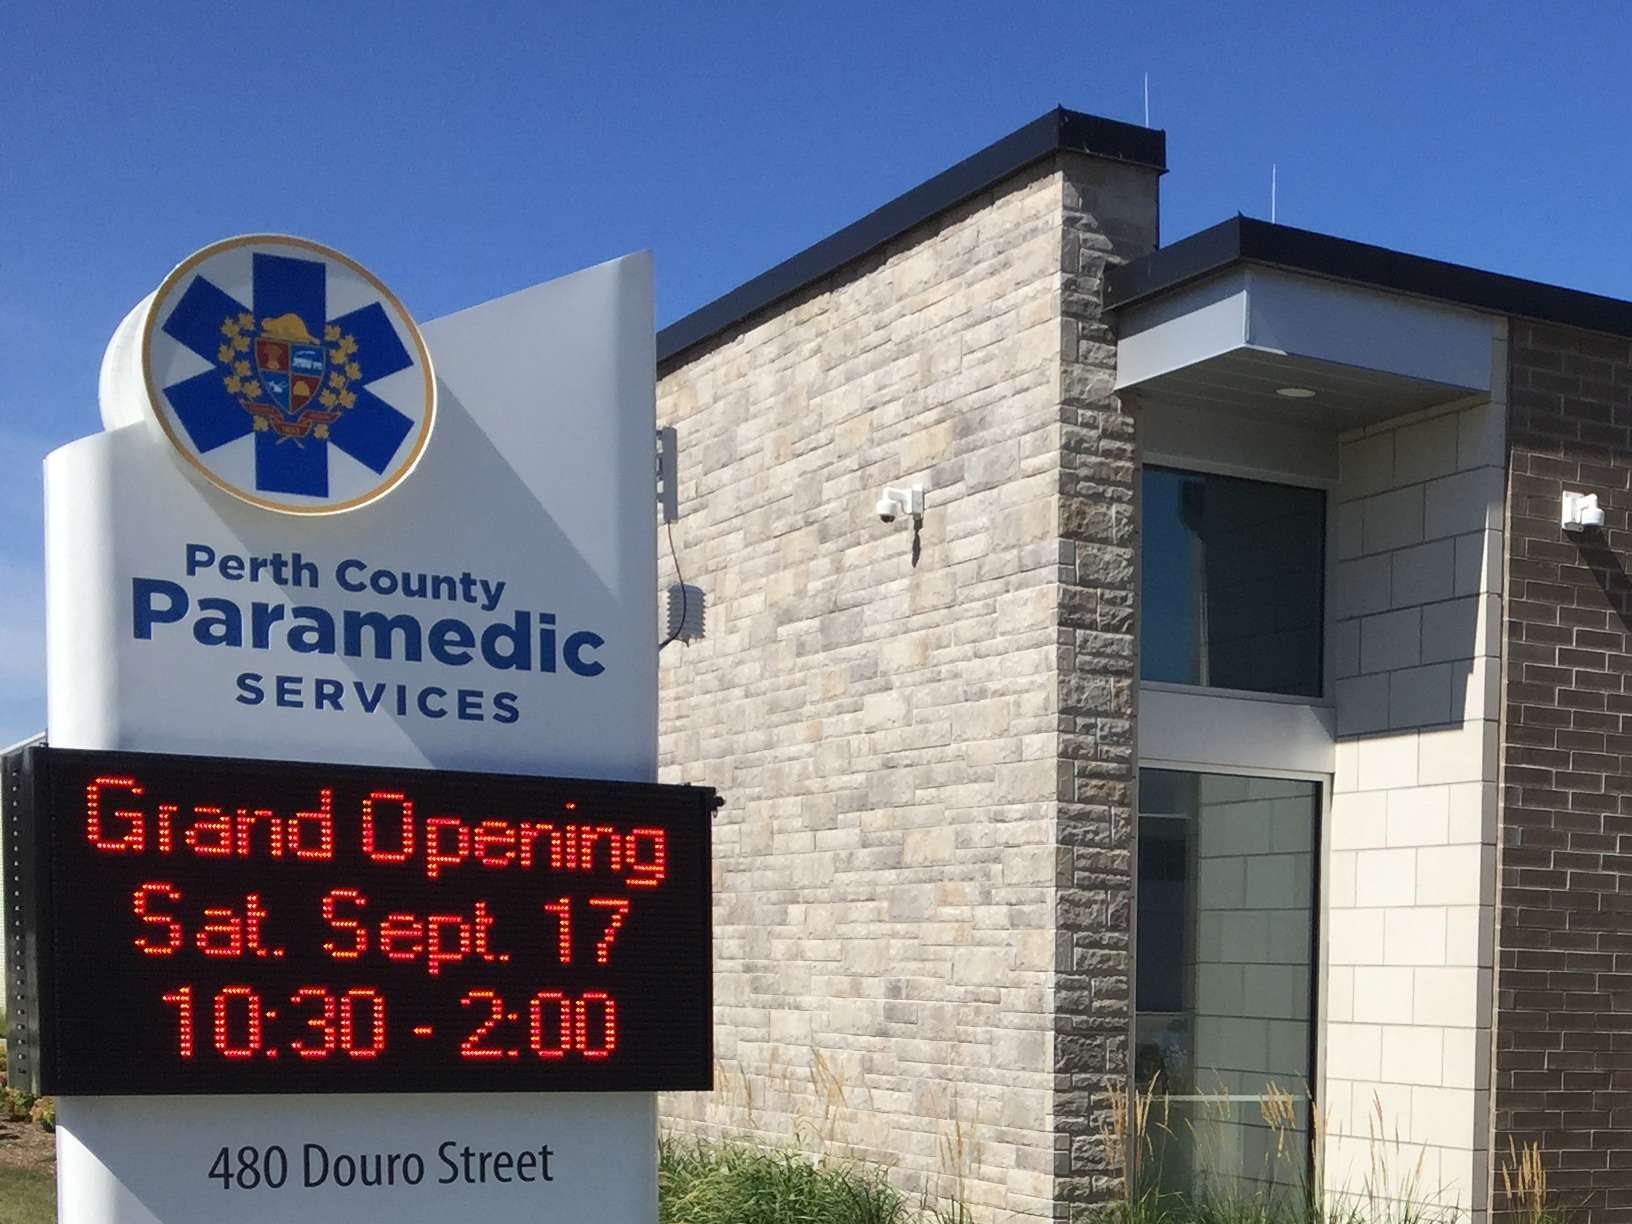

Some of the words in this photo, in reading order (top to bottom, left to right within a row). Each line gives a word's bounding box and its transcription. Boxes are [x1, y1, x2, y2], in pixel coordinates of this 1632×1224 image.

[185, 543, 320, 589] Perth
[335, 558, 507, 612] County
[131, 577, 606, 678] Paramedic
[235, 672, 520, 724] SERVICES
[86, 776, 334, 862] Grand
[361, 791, 668, 888] Opening
[132, 881, 285, 958] Sat.
[321, 888, 510, 976] Sept.
[543, 896, 630, 964] 17
[162, 985, 386, 1059] 10:30
[412, 1025, 434, 1037] -
[460, 990, 618, 1059] 2:00
[207, 1144, 289, 1191] 480
[302, 1142, 425, 1189] Douro
[437, 1139, 555, 1185] Street
